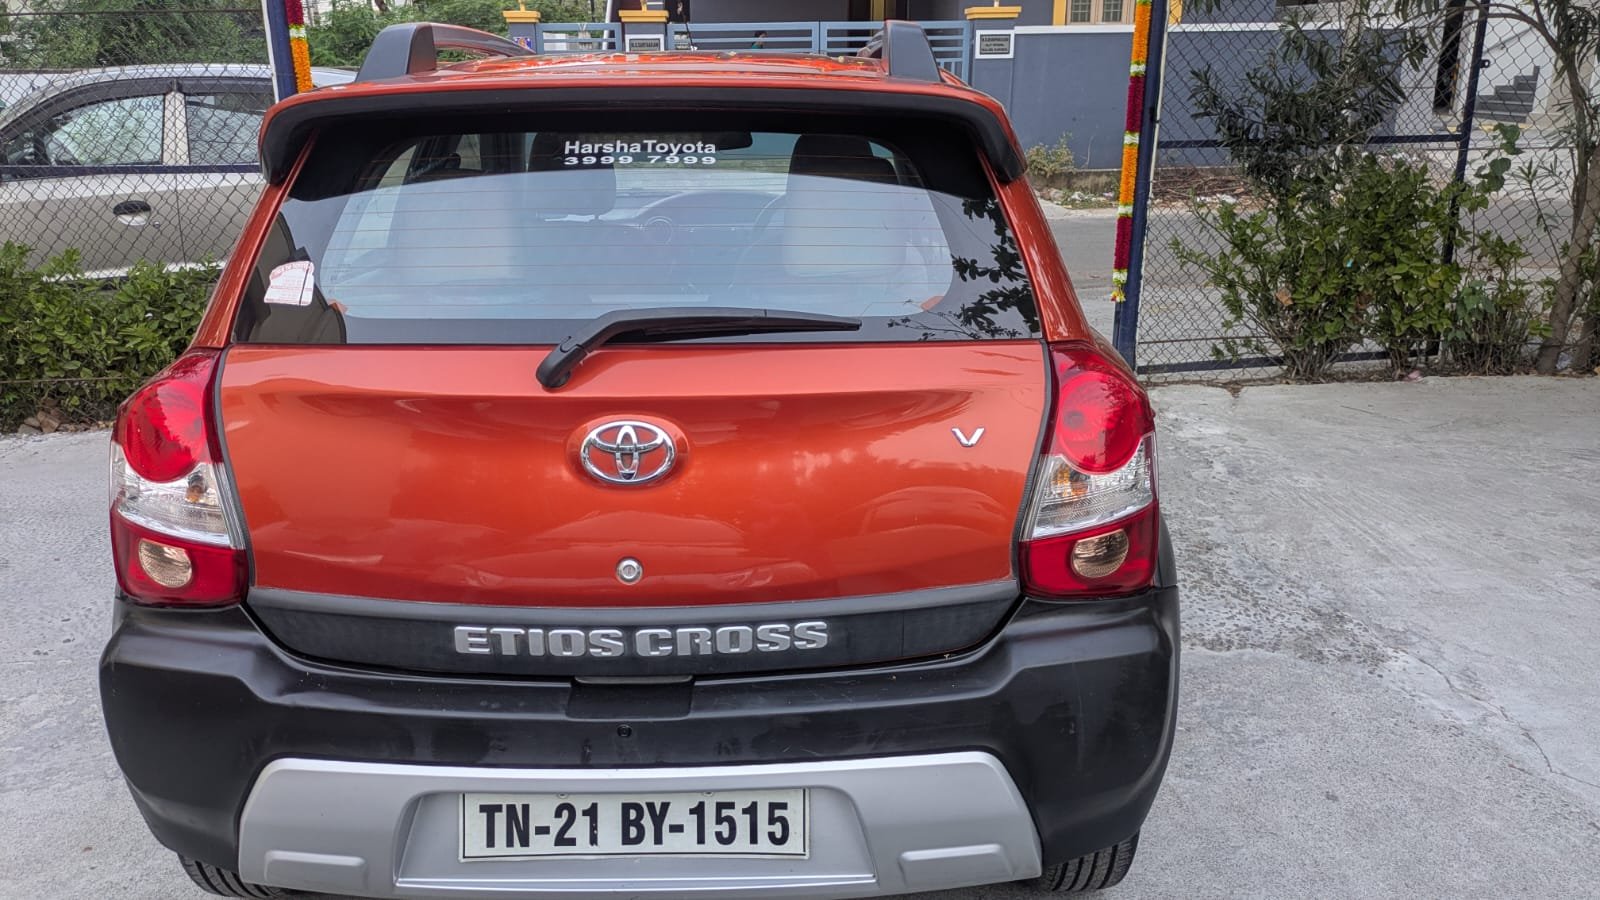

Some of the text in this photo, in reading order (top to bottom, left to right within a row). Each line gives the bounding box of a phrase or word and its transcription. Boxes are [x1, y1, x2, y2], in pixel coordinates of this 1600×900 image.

[564, 139, 716, 156] Harsha Toyota
[564, 155, 716, 165] 3999 7999
[951, 427, 985, 447] V
[454, 621, 829, 657] ETIOS CROSS
[479, 801, 790, 848] TN-21 BY-1515
